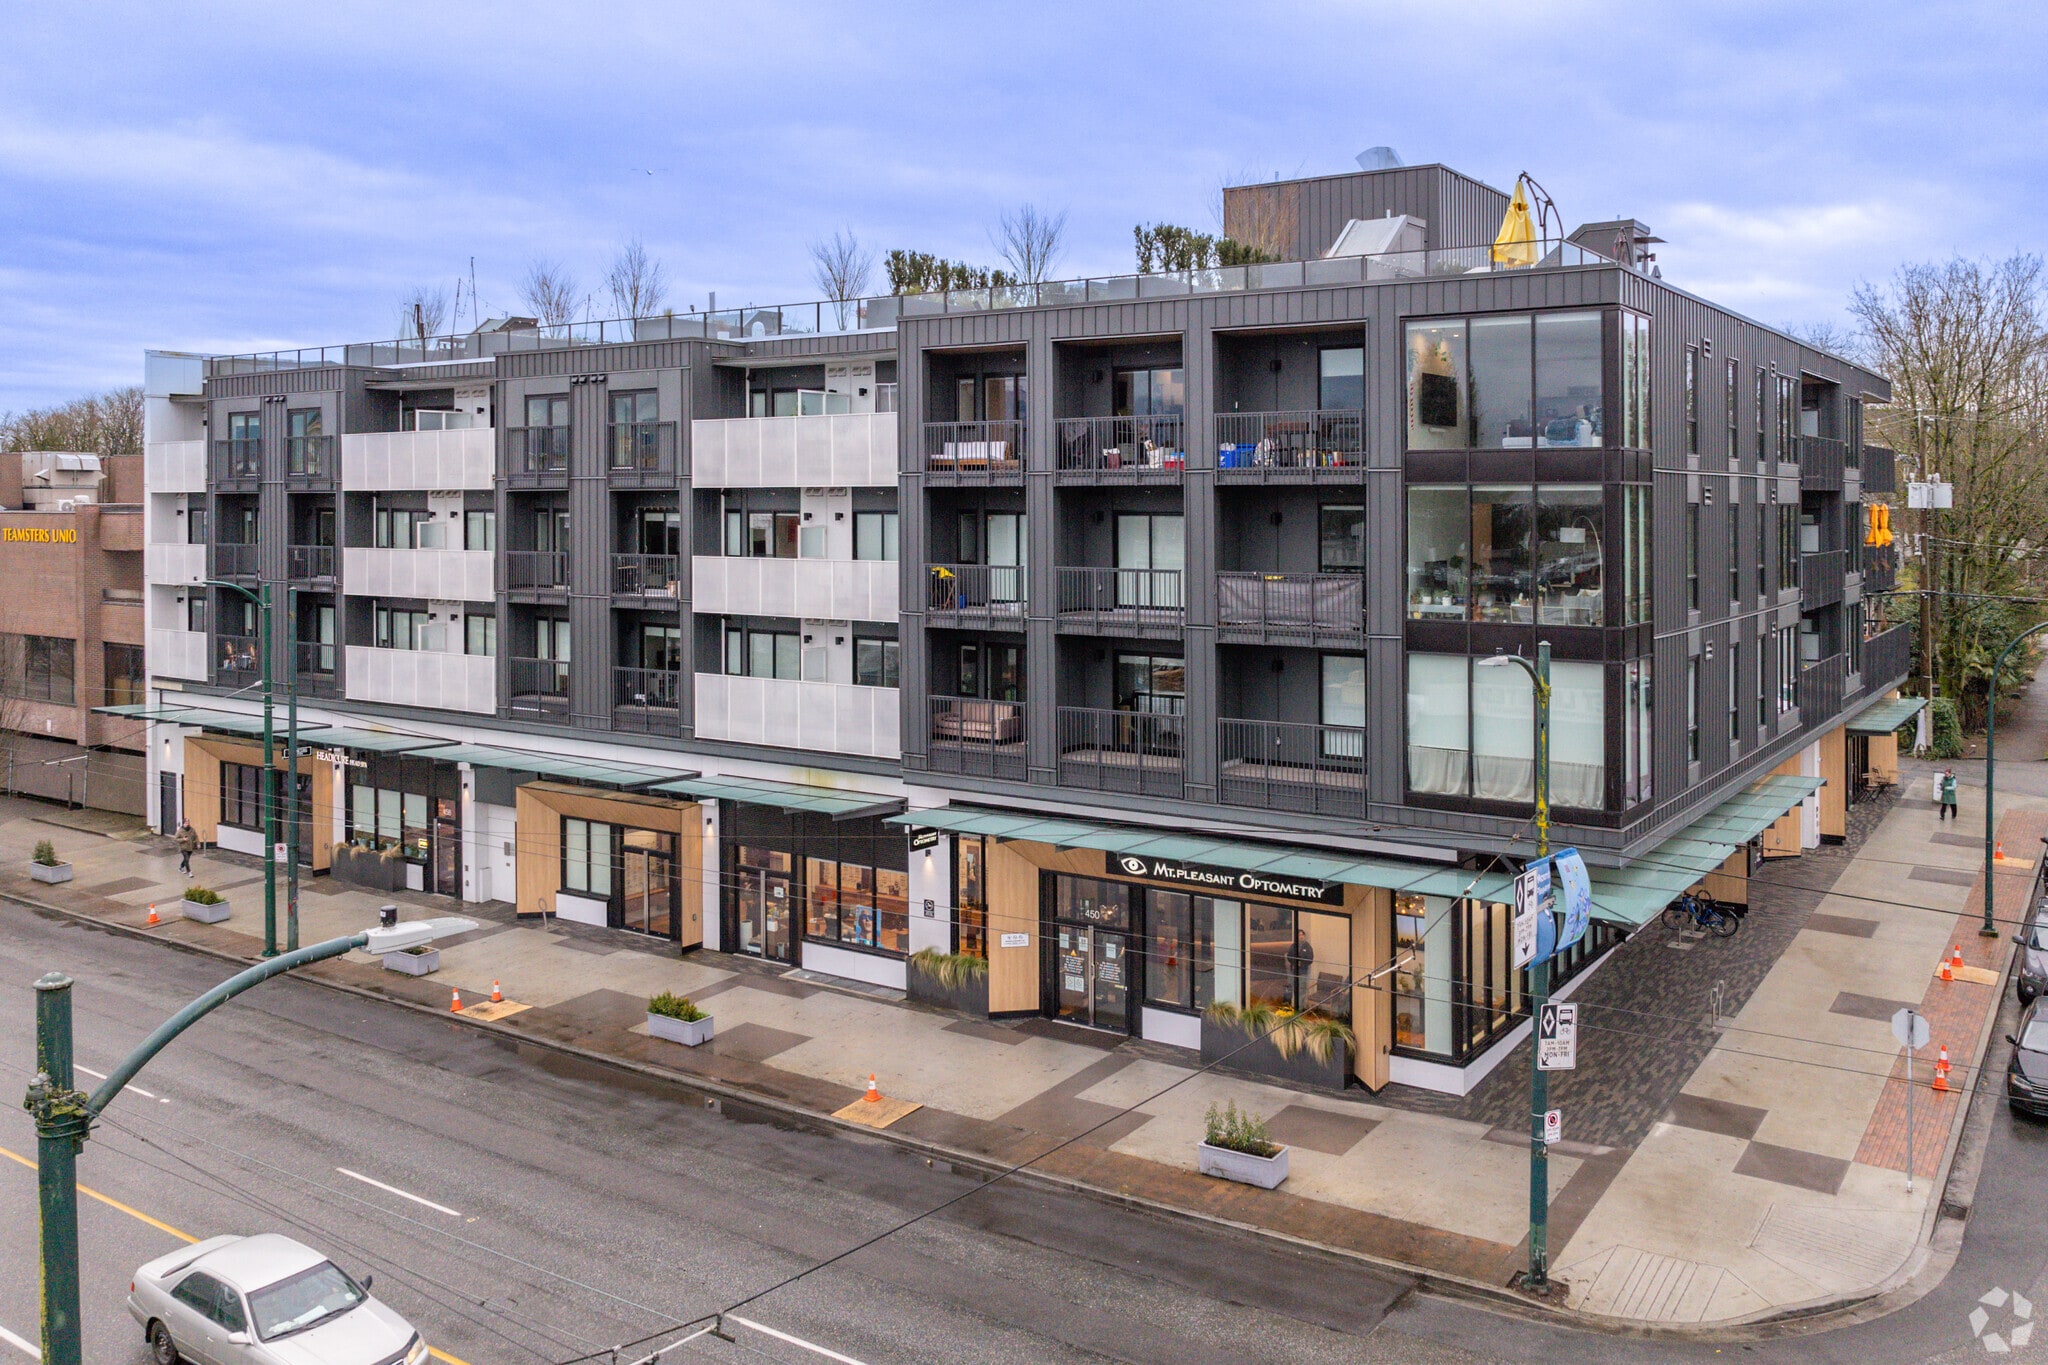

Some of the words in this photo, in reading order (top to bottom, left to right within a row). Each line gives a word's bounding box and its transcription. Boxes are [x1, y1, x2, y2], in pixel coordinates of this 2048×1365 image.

[3, 528, 50, 543] TEAMSTERS
[1239, 874, 1325, 899] OPTOMETRY
[1085, 909, 1100, 920] 450
